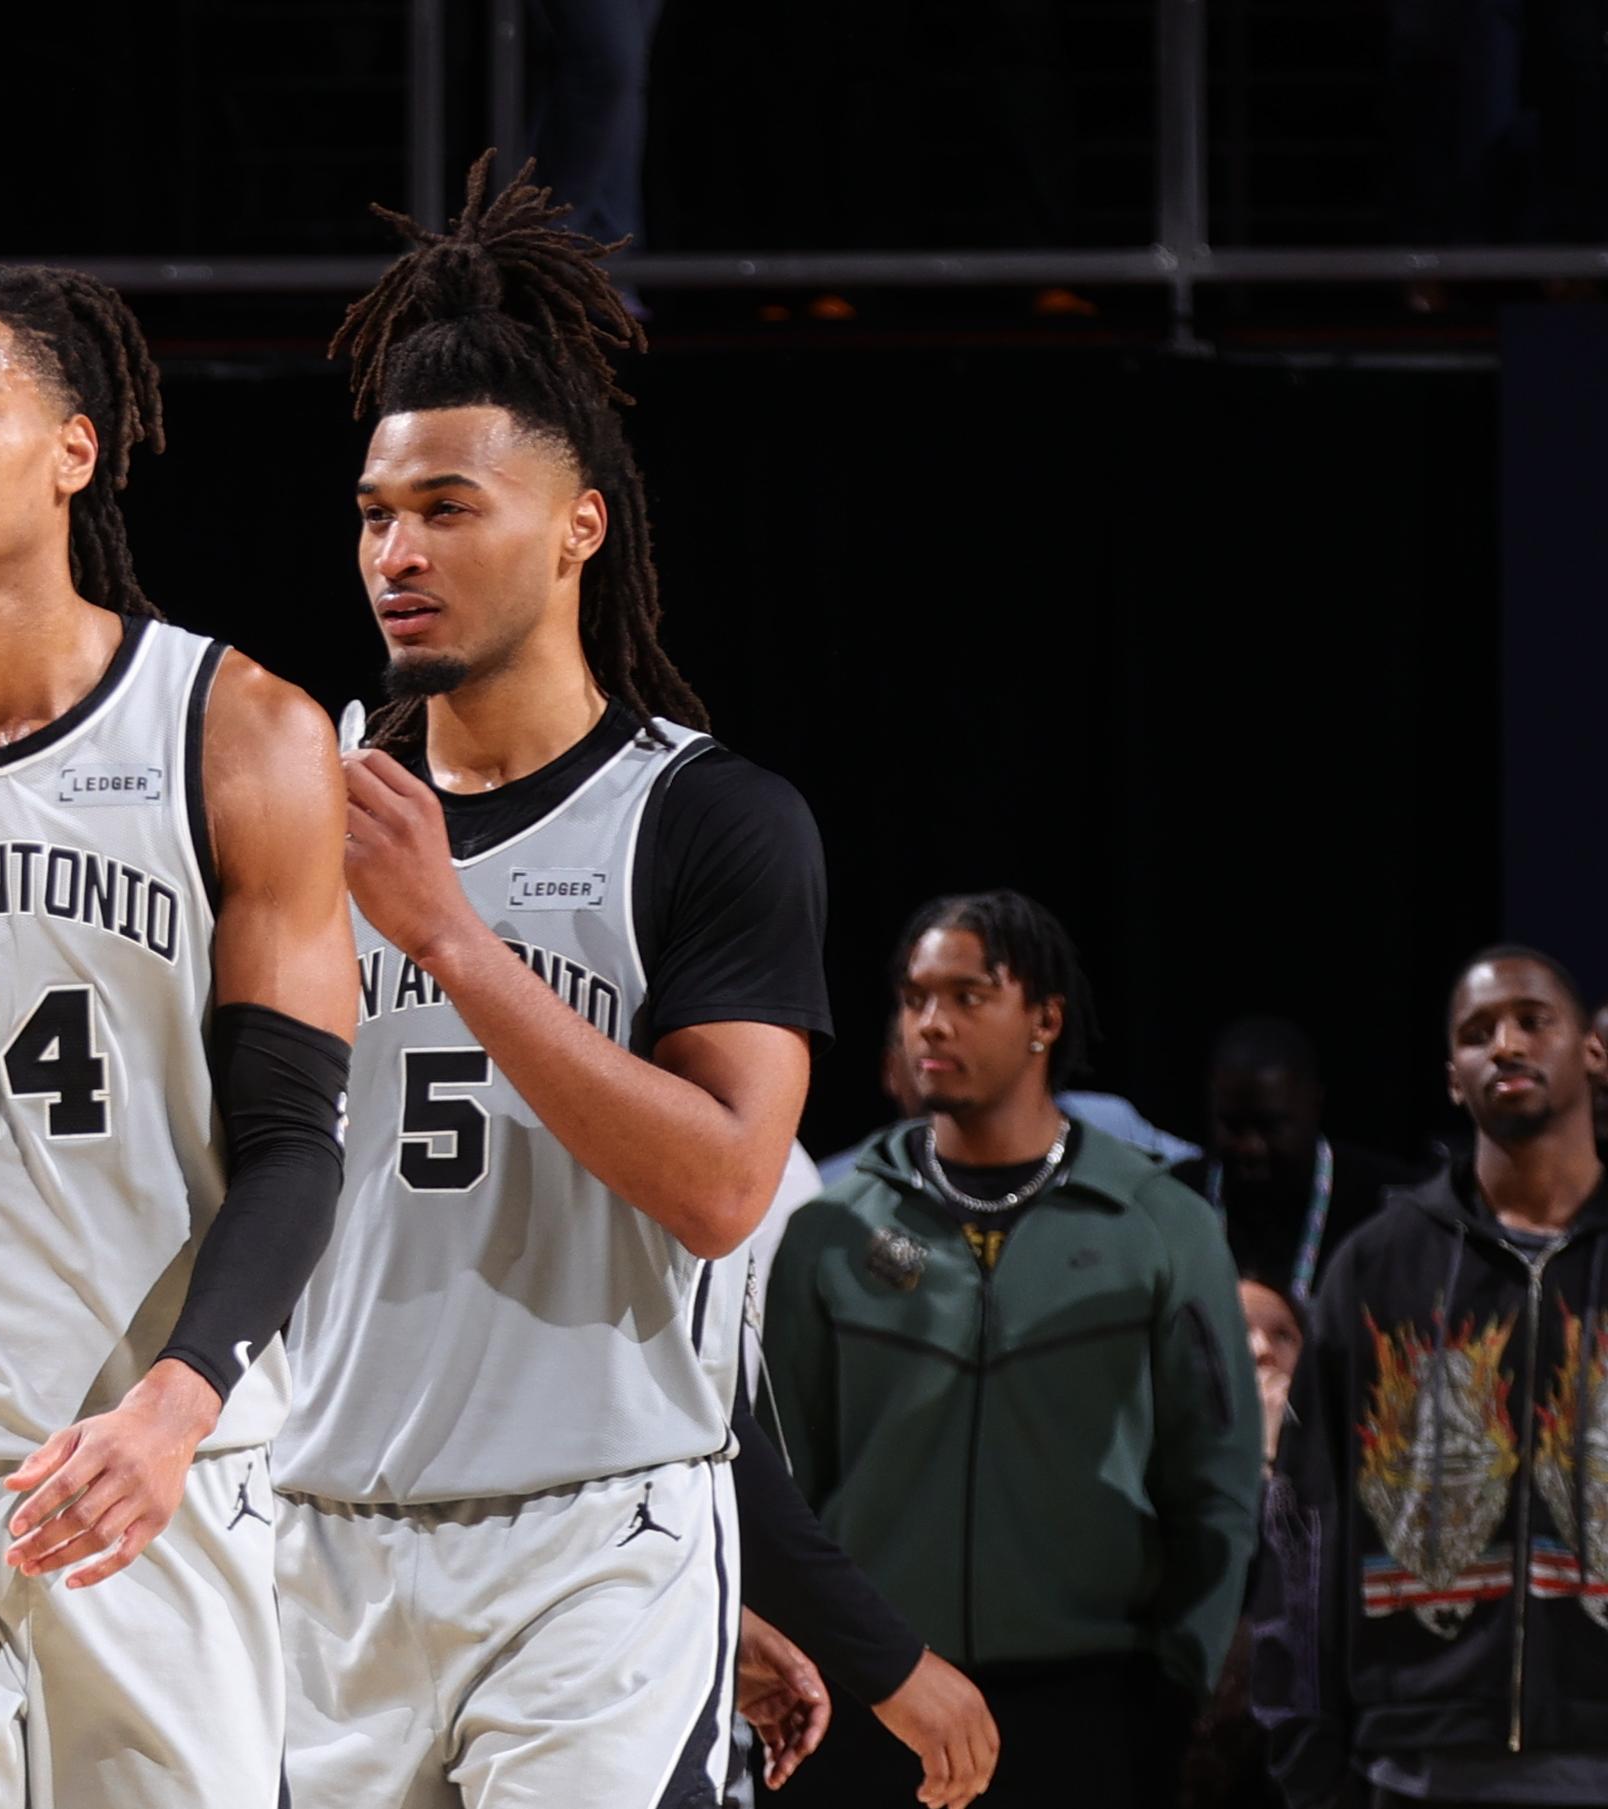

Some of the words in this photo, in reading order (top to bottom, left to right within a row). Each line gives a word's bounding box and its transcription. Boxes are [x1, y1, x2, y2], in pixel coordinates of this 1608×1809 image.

[72, 775, 149, 793] LEDGER
[522, 882, 593, 897] LEDGER
[395, 1046, 493, 1194] 5
